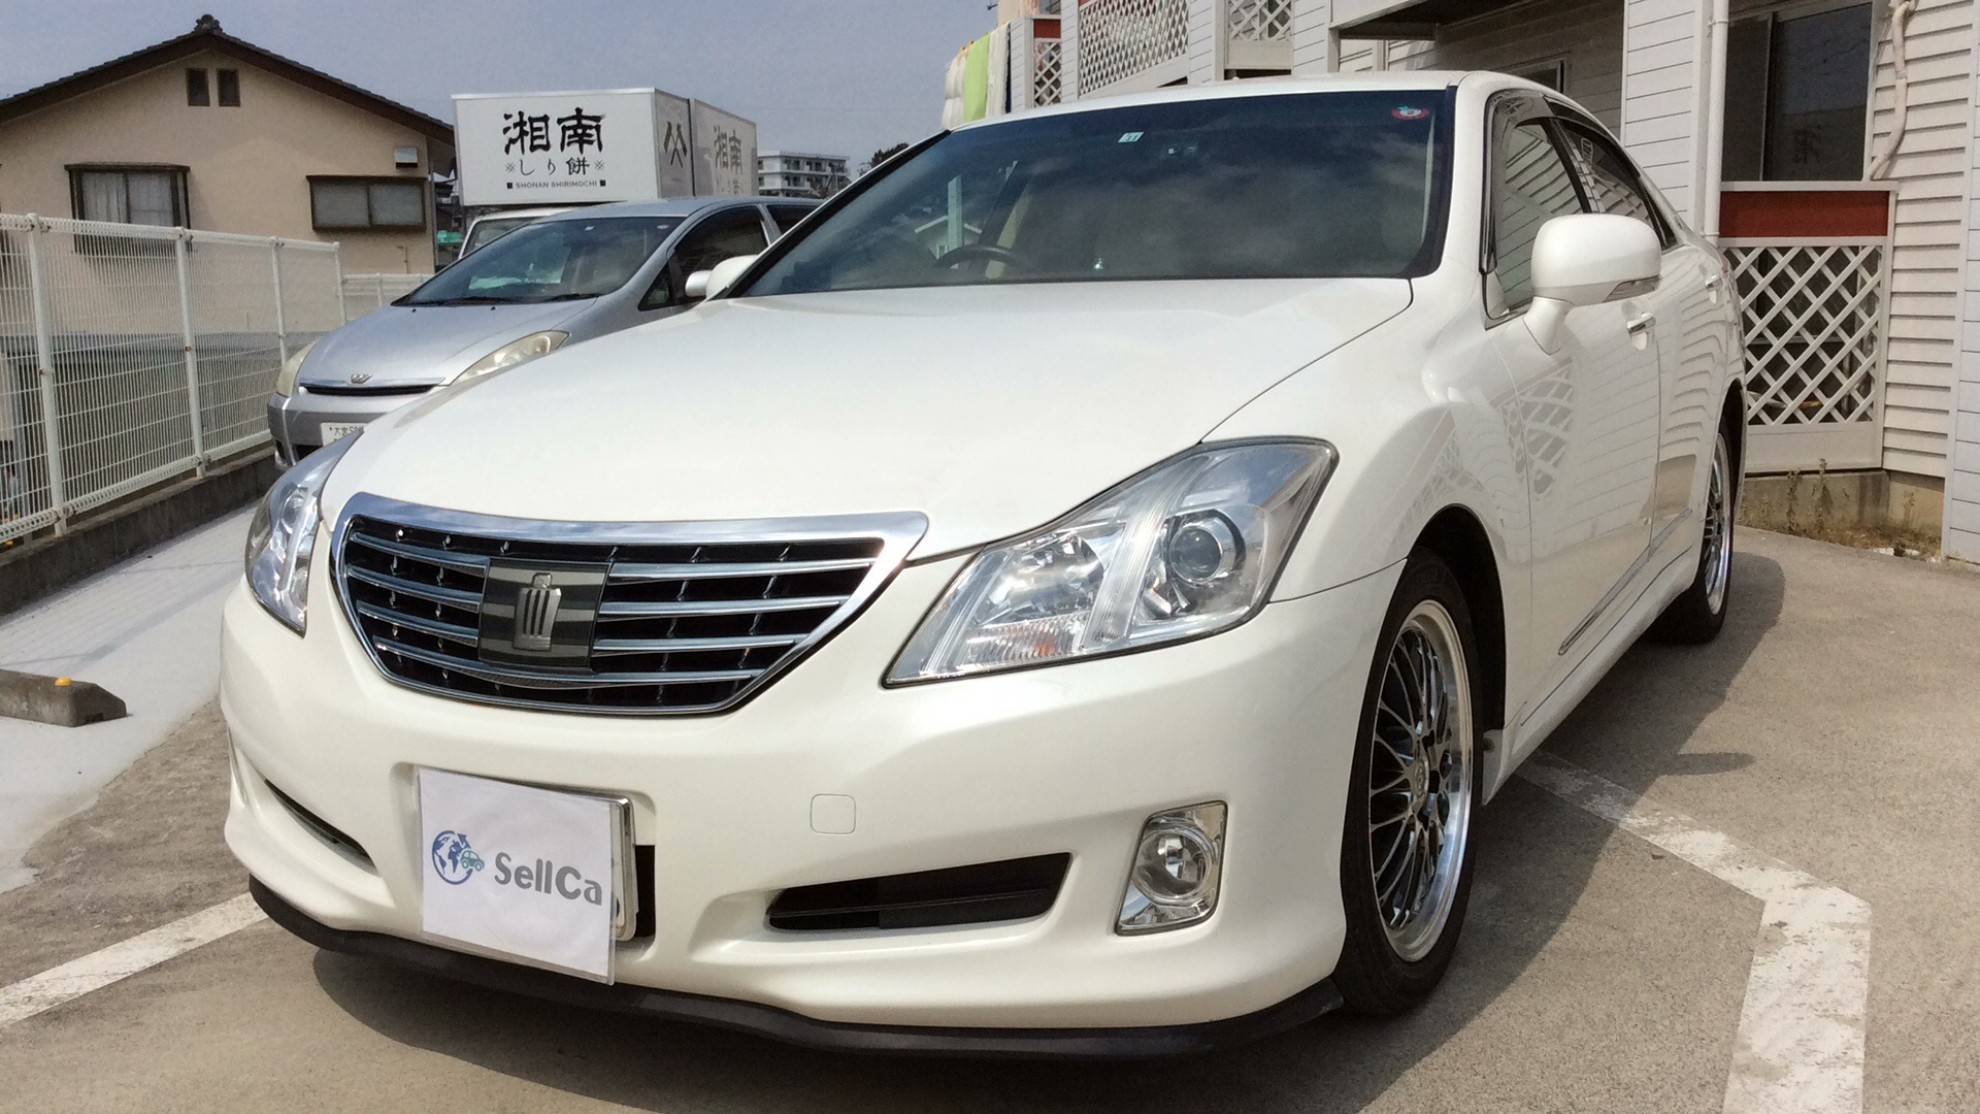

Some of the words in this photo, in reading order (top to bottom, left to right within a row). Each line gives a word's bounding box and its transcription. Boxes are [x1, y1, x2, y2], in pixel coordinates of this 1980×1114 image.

[502, 106, 606, 155] 湘南
[515, 181, 549, 189] SHONAN
[551, 179, 598, 188] SHIRIMOCHI
[494, 852, 603, 906] SellCa
